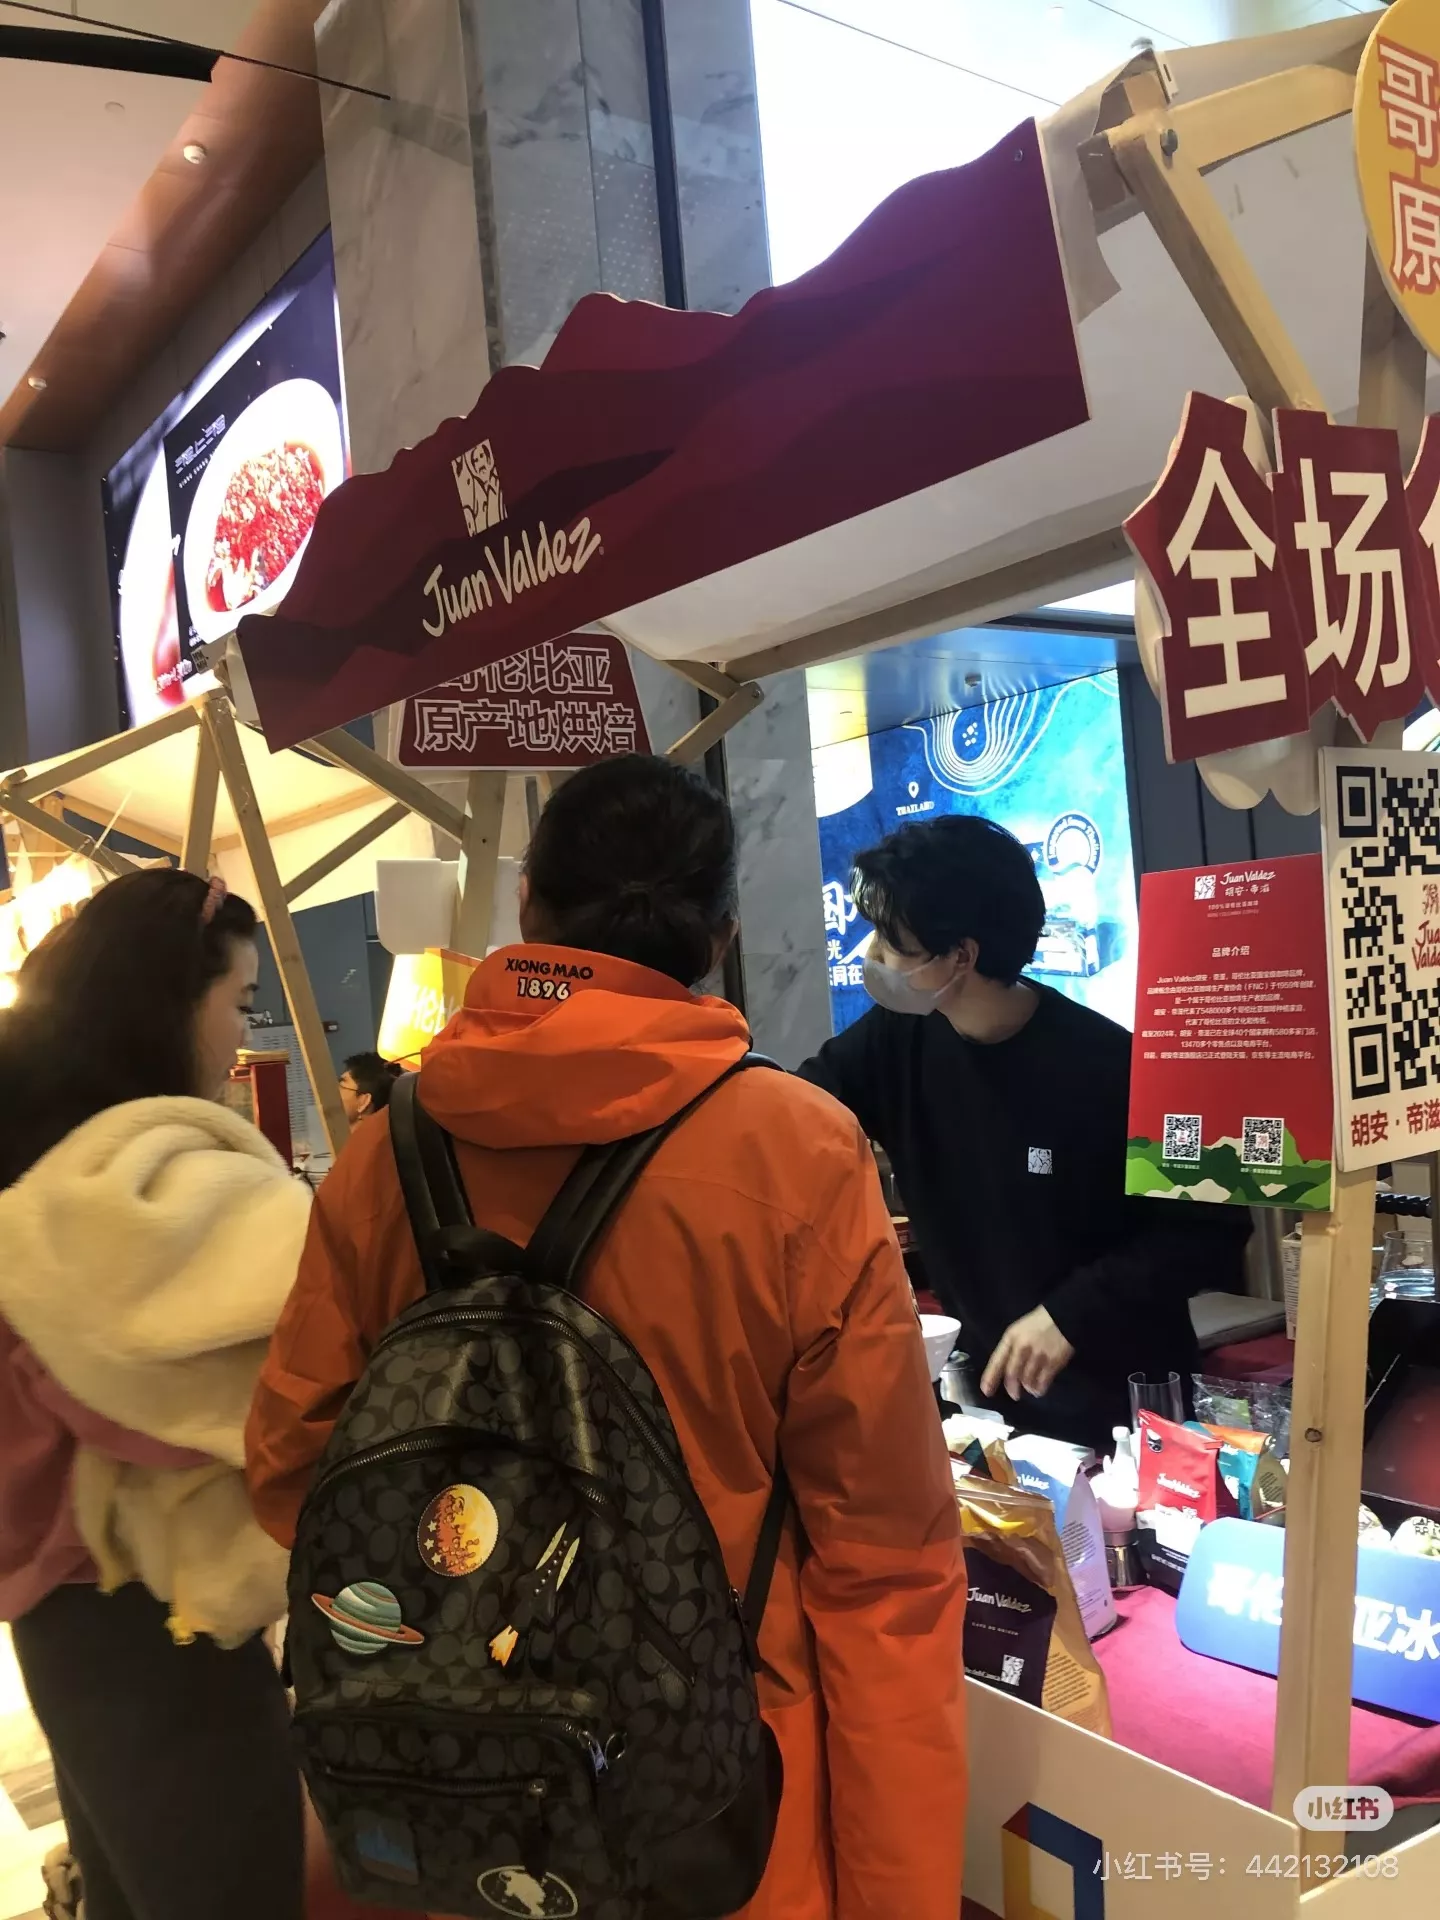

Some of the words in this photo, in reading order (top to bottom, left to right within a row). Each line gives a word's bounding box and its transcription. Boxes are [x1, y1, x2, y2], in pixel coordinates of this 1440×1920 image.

[1379, 42, 1440, 160] 哥
[422, 564, 493, 637] Juan
[485, 517, 602, 604] Valdez
[1166, 447, 1440, 718] 全场
[438, 642, 613, 694] 伦比亚
[413, 698, 637, 753] 原产地烘焙
[1220, 871, 1245, 885] Juan
[1244, 869, 1276, 882] Valdez
[505, 958, 551, 976] XIONG
[552, 963, 594, 980] MAO
[1212, 946, 1250, 958] 品牌介绍
[517, 976, 571, 1002] 1896
[966, 1587, 995, 1605] Juan
[994, 1592, 1032, 1613] Valdez
